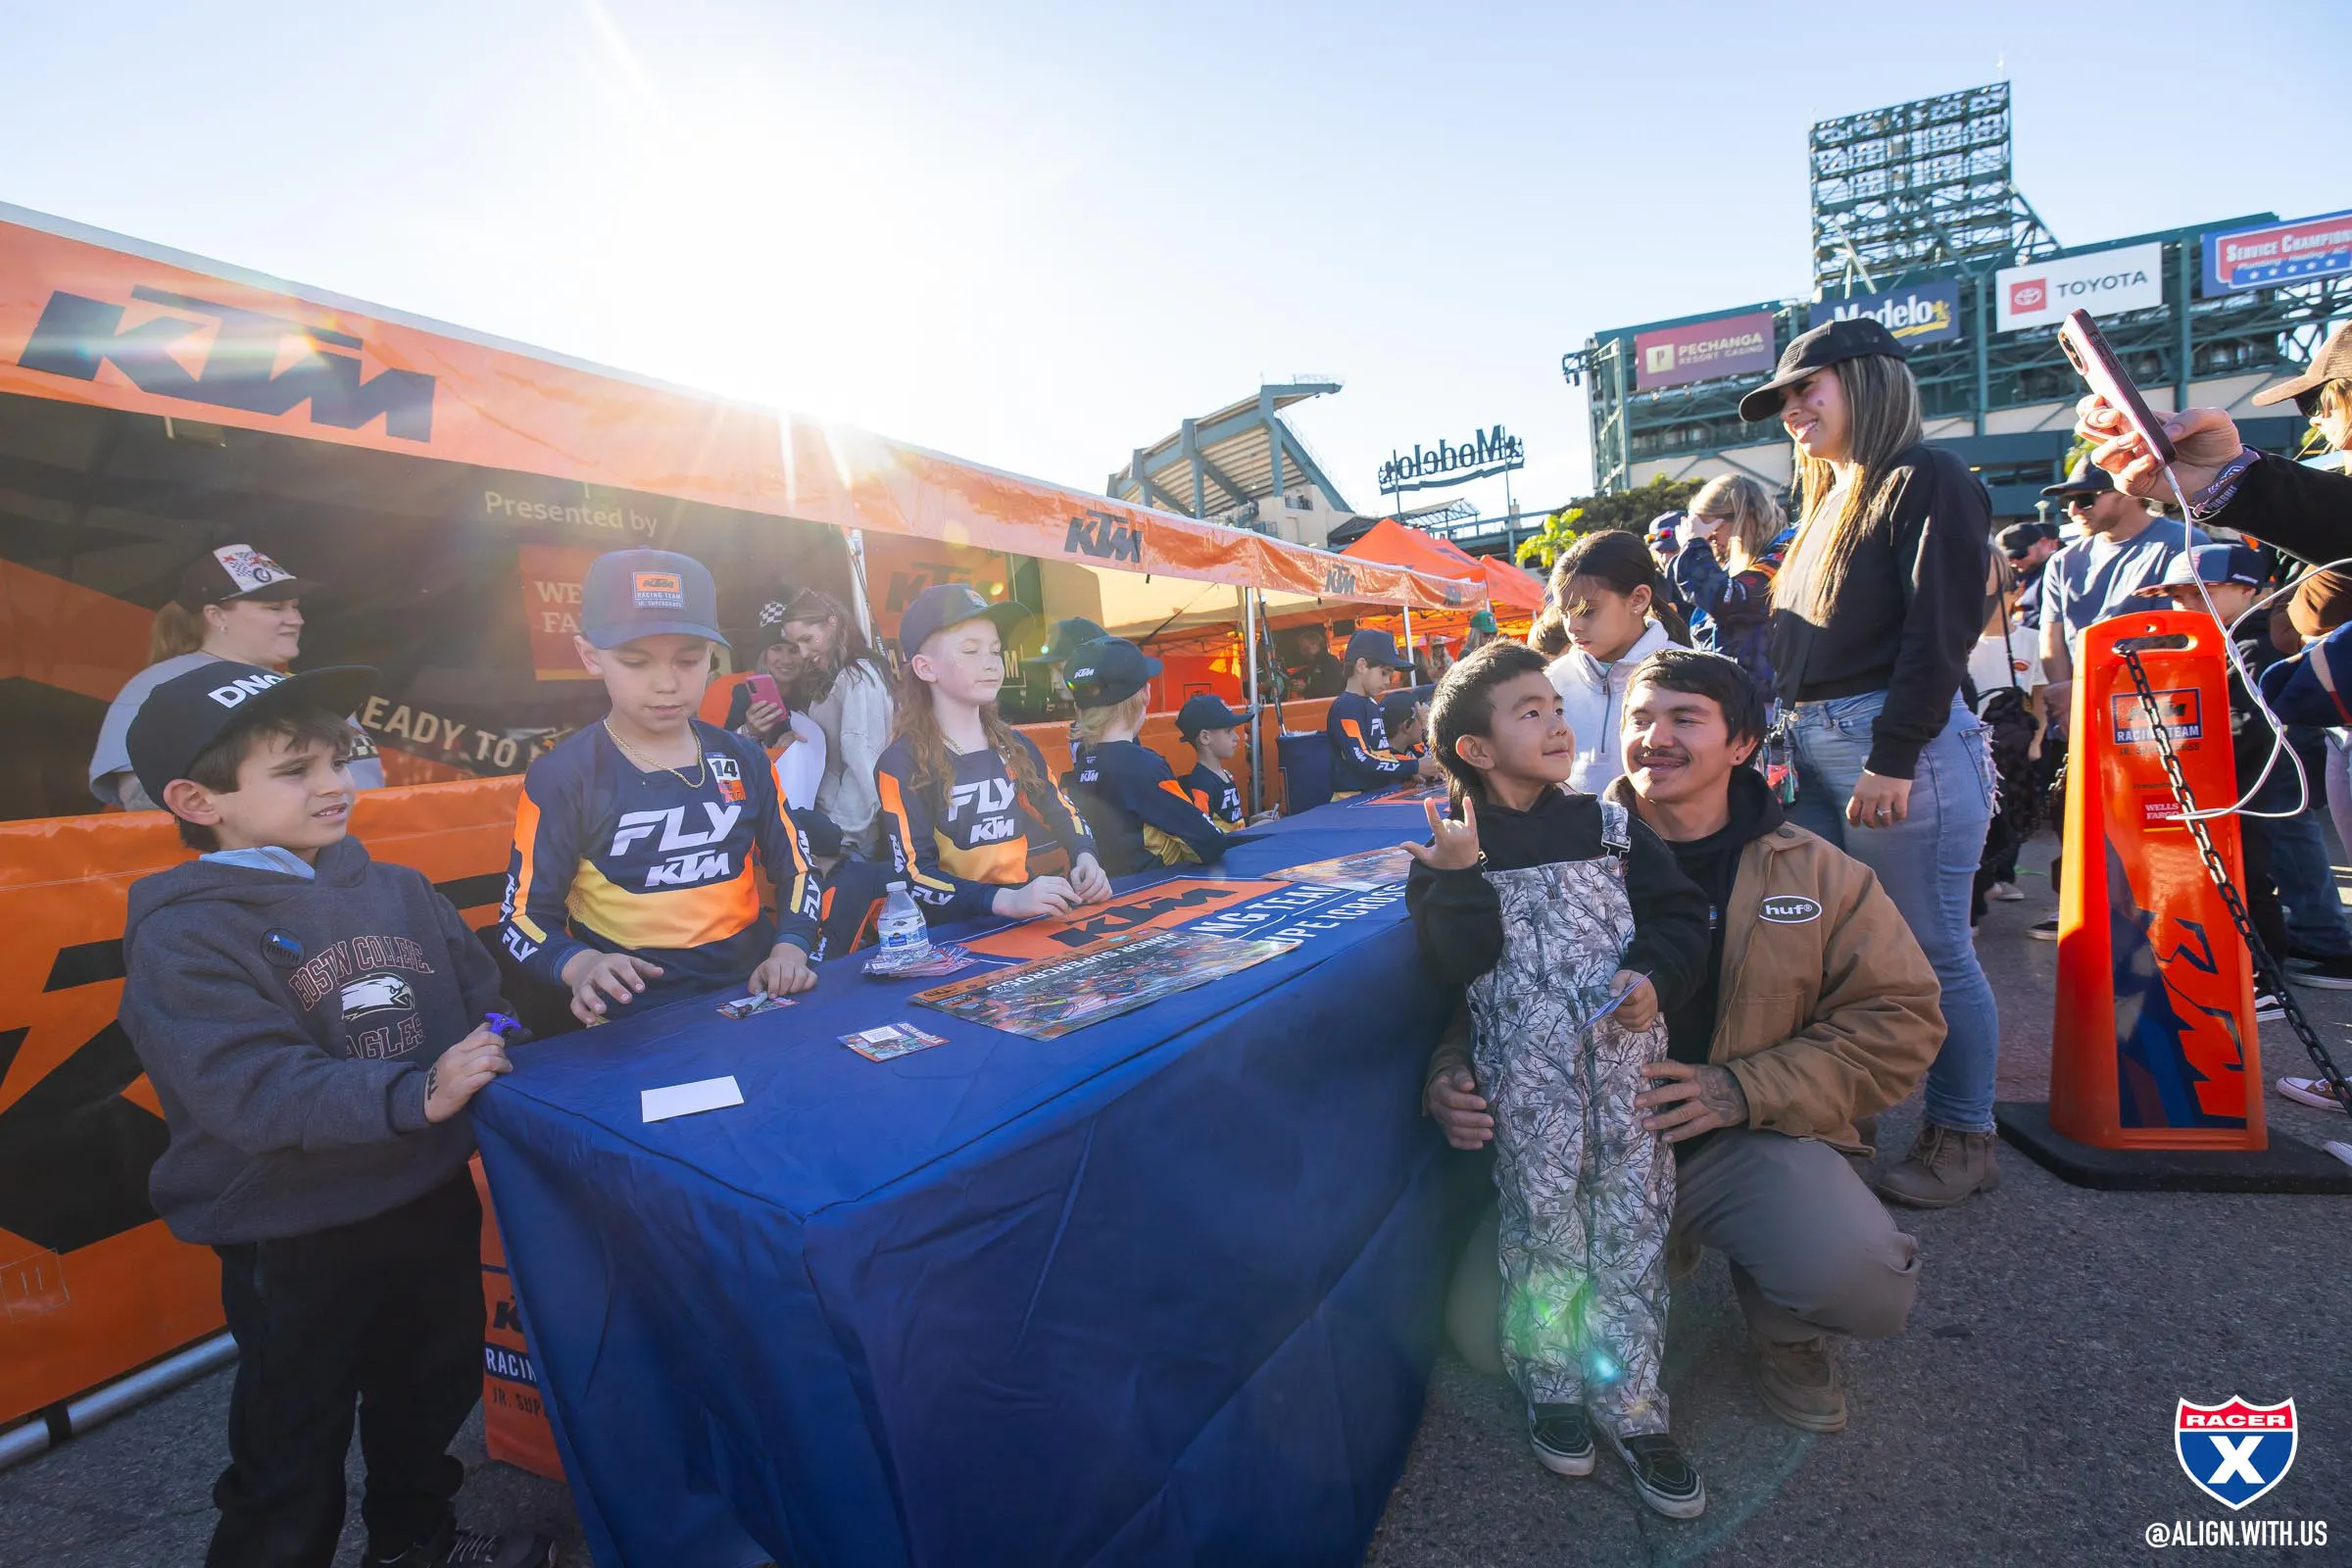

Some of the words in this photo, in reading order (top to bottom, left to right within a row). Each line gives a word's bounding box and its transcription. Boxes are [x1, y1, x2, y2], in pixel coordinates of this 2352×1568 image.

[2226, 242, 2278, 263] SERVICE
[2281, 228, 2352, 253] CHAMPION
[2057, 270, 2147, 298] TOYOTA
[1678, 332, 1764, 357] PECHANGA
[17, 284, 436, 444] KTM
[484, 491, 623, 528] Presented
[630, 508, 659, 538] by
[1063, 509, 1143, 564] KTM
[1325, 564, 1355, 595] KTM
[1074, 667, 1096, 679] KTM
[475, 730, 517, 768] TO
[2167, 725, 2199, 740] TEAM
[712, 760, 739, 777] 14
[1079, 769, 1099, 783] KTM
[1376, 761, 1400, 771] FLY
[948, 777, 1015, 822] FLY
[2145, 803, 2179, 811] WELLS
[610, 802, 742, 857] FLY
[969, 815, 1014, 845] KTM
[644, 849, 731, 887] KTM
[804, 874, 821, 922] FLY
[910, 885, 956, 906] FLY
[1047, 888, 1239, 948] KTM
[352, 936, 429, 973] COLLEGE
[502, 926, 539, 962] FLY
[1115, 932, 1180, 955] JUNIOR
[987, 950, 1119, 993] SUPERCROSS
[485, 1348, 537, 1382] RACIN
[514, 1393, 541, 1418] SUP
